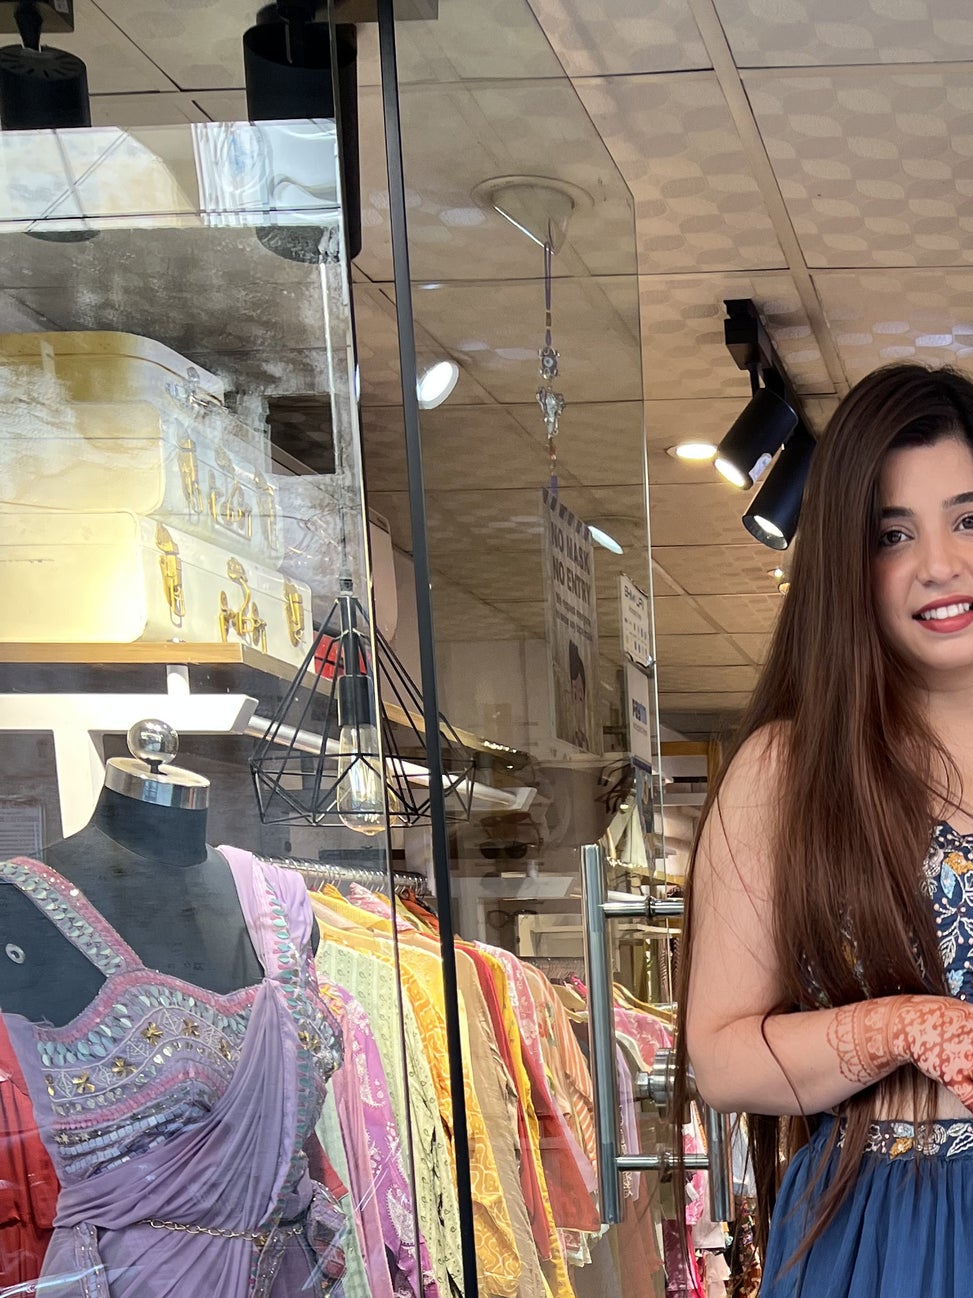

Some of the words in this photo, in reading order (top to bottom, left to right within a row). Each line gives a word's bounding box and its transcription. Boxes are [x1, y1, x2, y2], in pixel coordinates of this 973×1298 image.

[551, 521, 564, 552] NO
[566, 535, 590, 575] MASK
[553, 556, 565, 586] NO
[566, 567, 591, 606] ENTRY
